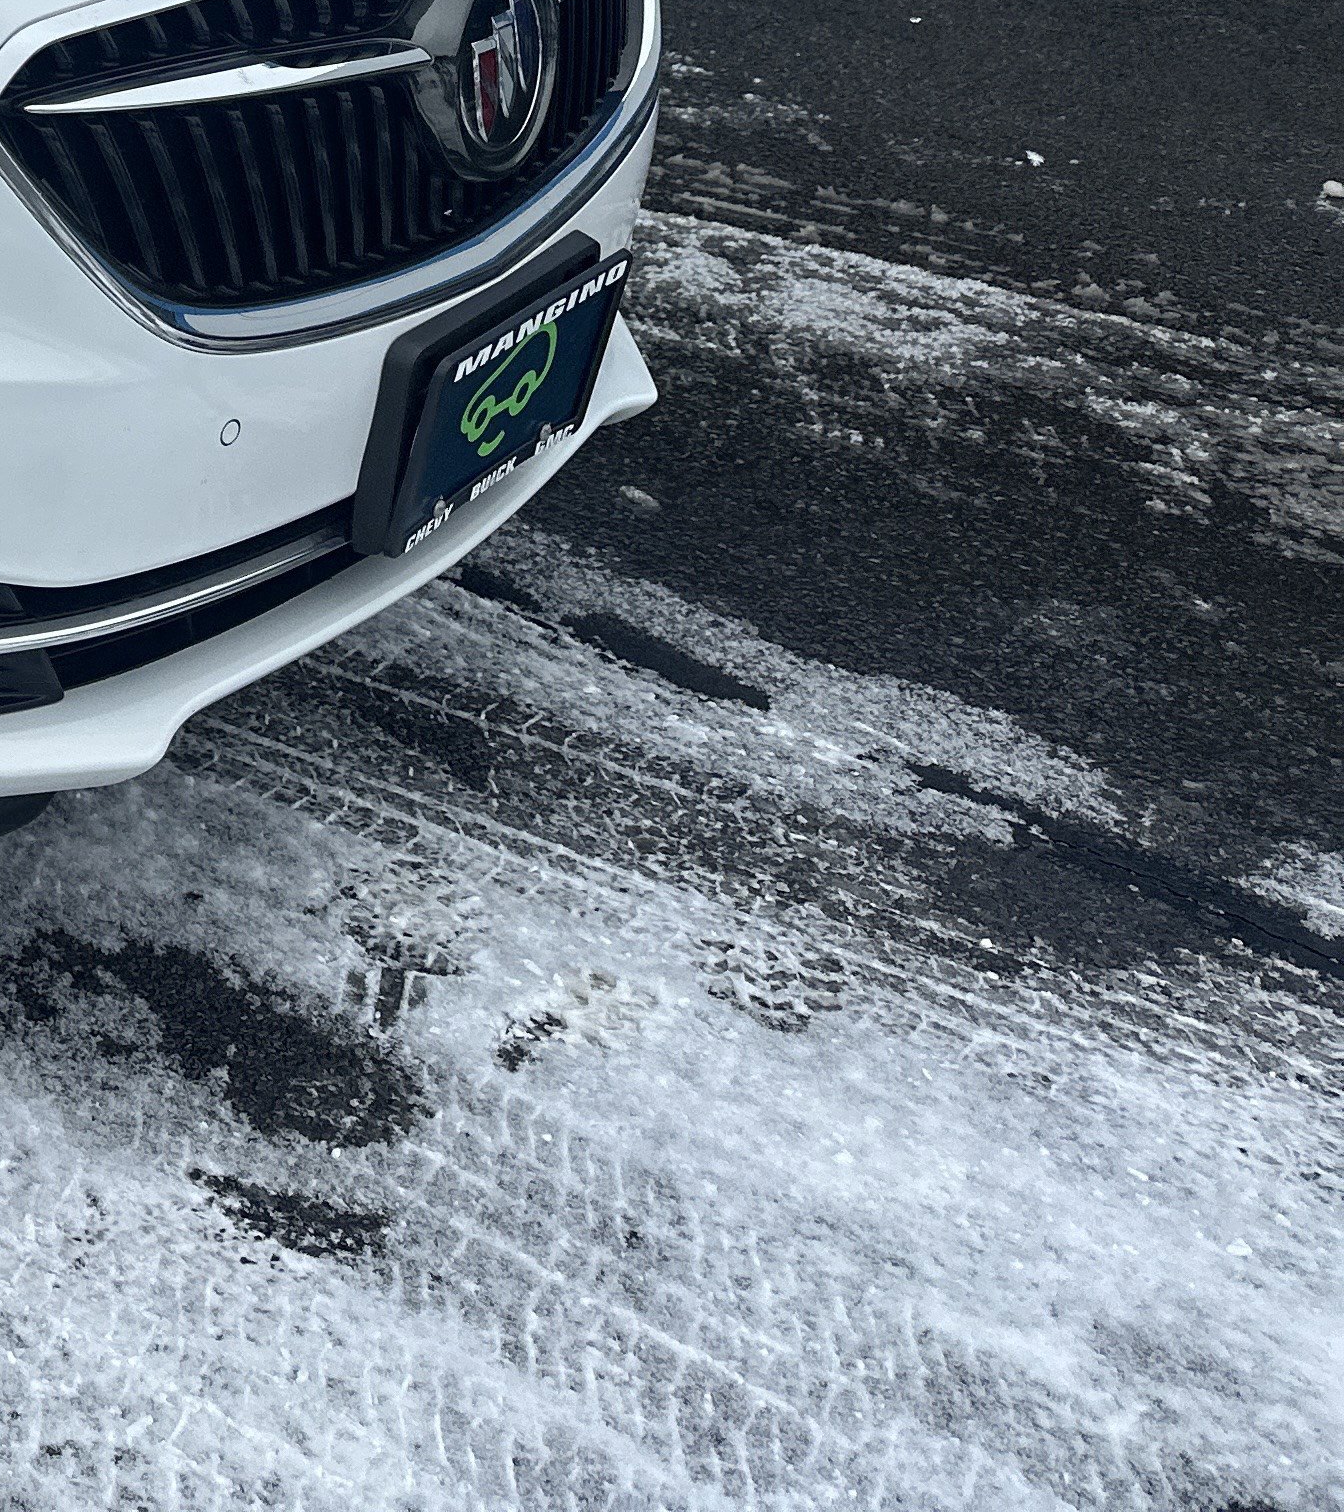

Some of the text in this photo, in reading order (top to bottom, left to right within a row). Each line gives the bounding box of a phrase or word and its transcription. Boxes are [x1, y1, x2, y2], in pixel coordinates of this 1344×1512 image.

[454, 260, 628, 383] MANGINO
[405, 424, 575, 554] CHEVY BUICK GMC
